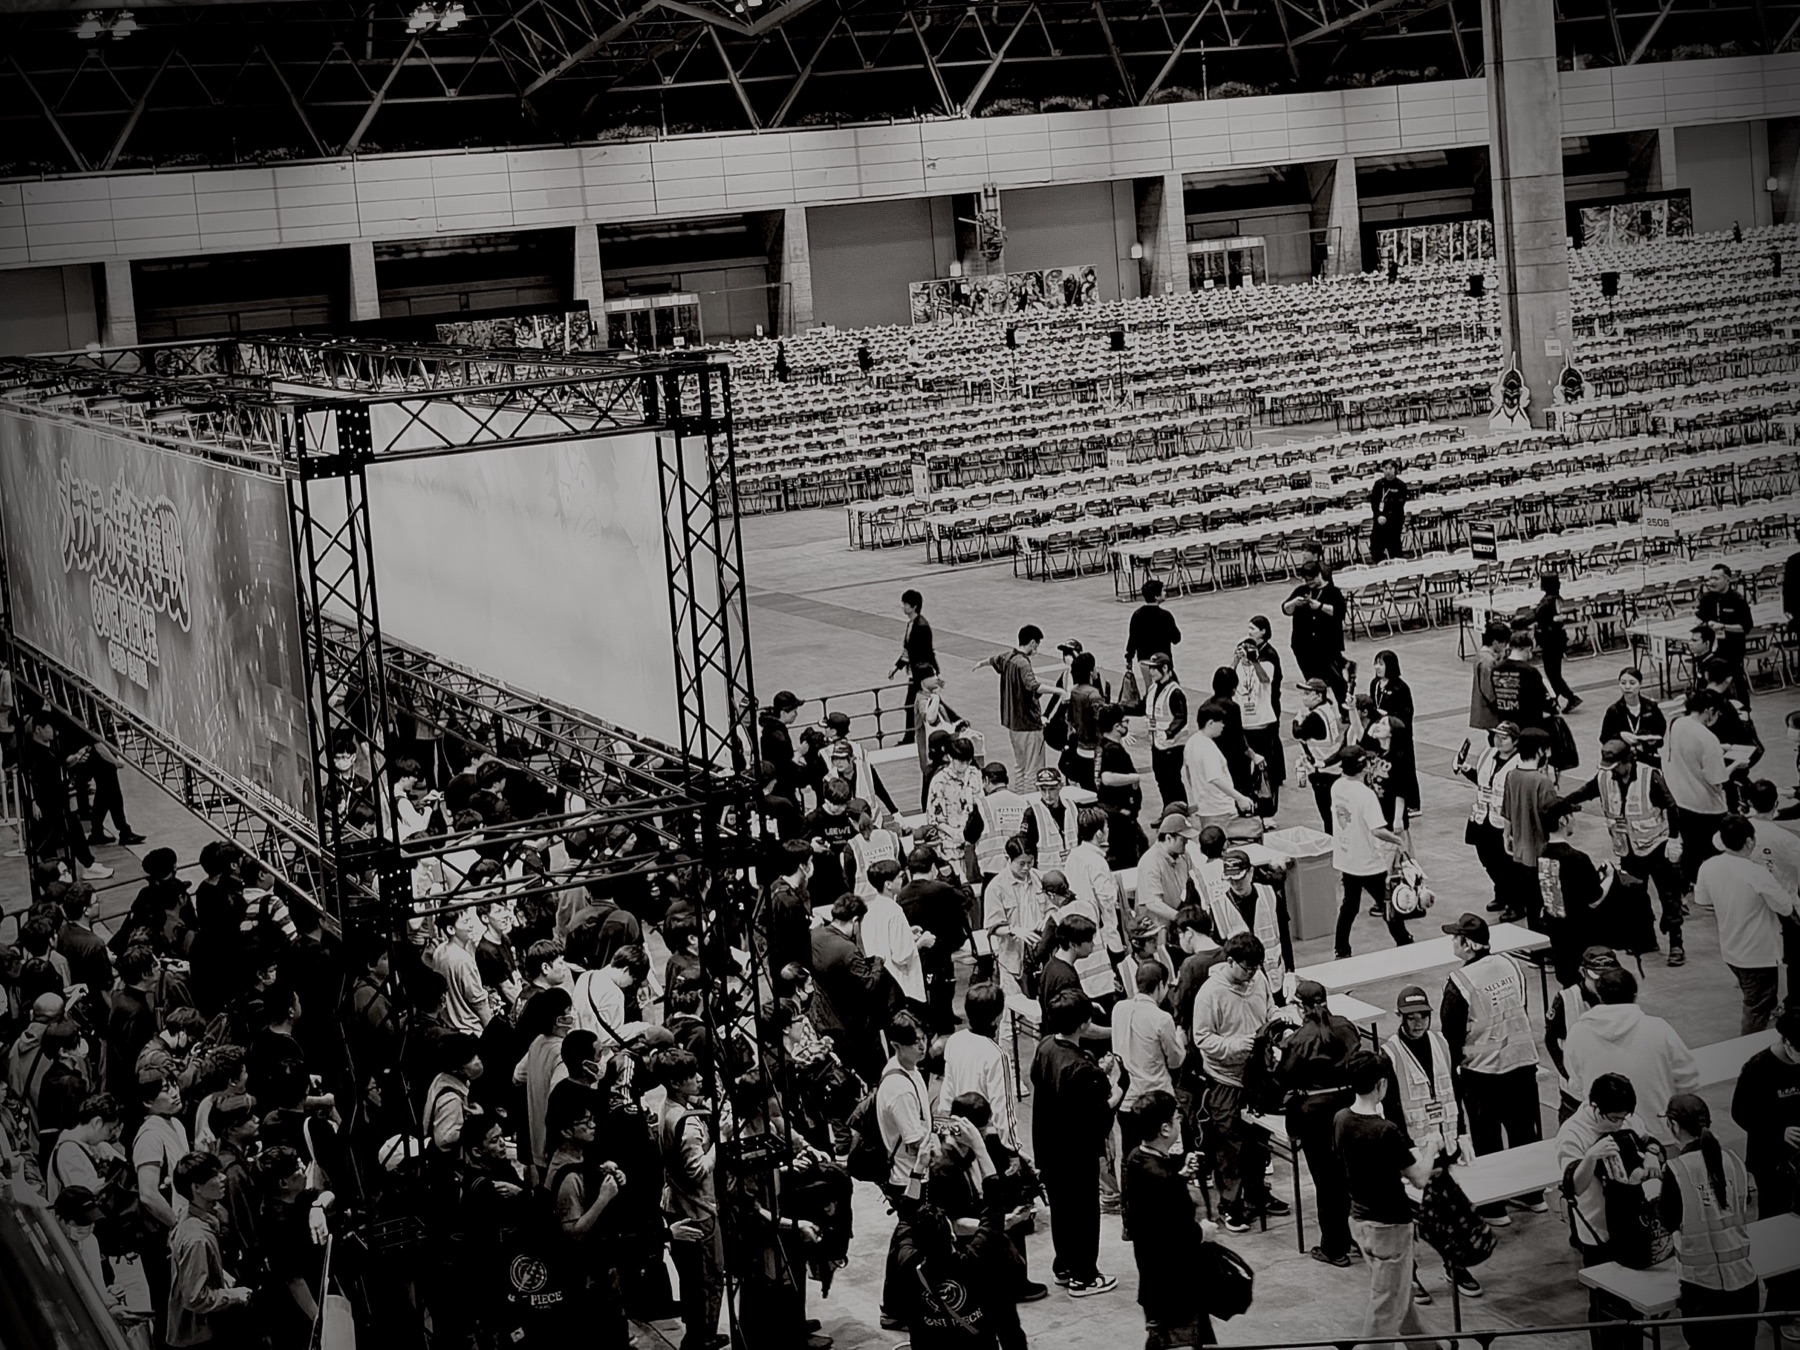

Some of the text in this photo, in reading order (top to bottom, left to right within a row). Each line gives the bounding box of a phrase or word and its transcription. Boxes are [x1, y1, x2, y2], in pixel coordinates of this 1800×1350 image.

[1646, 517, 1670, 528] 2508
[91, 574, 159, 667] ONE PIECE
[531, 1291, 563, 1306] PIECE
